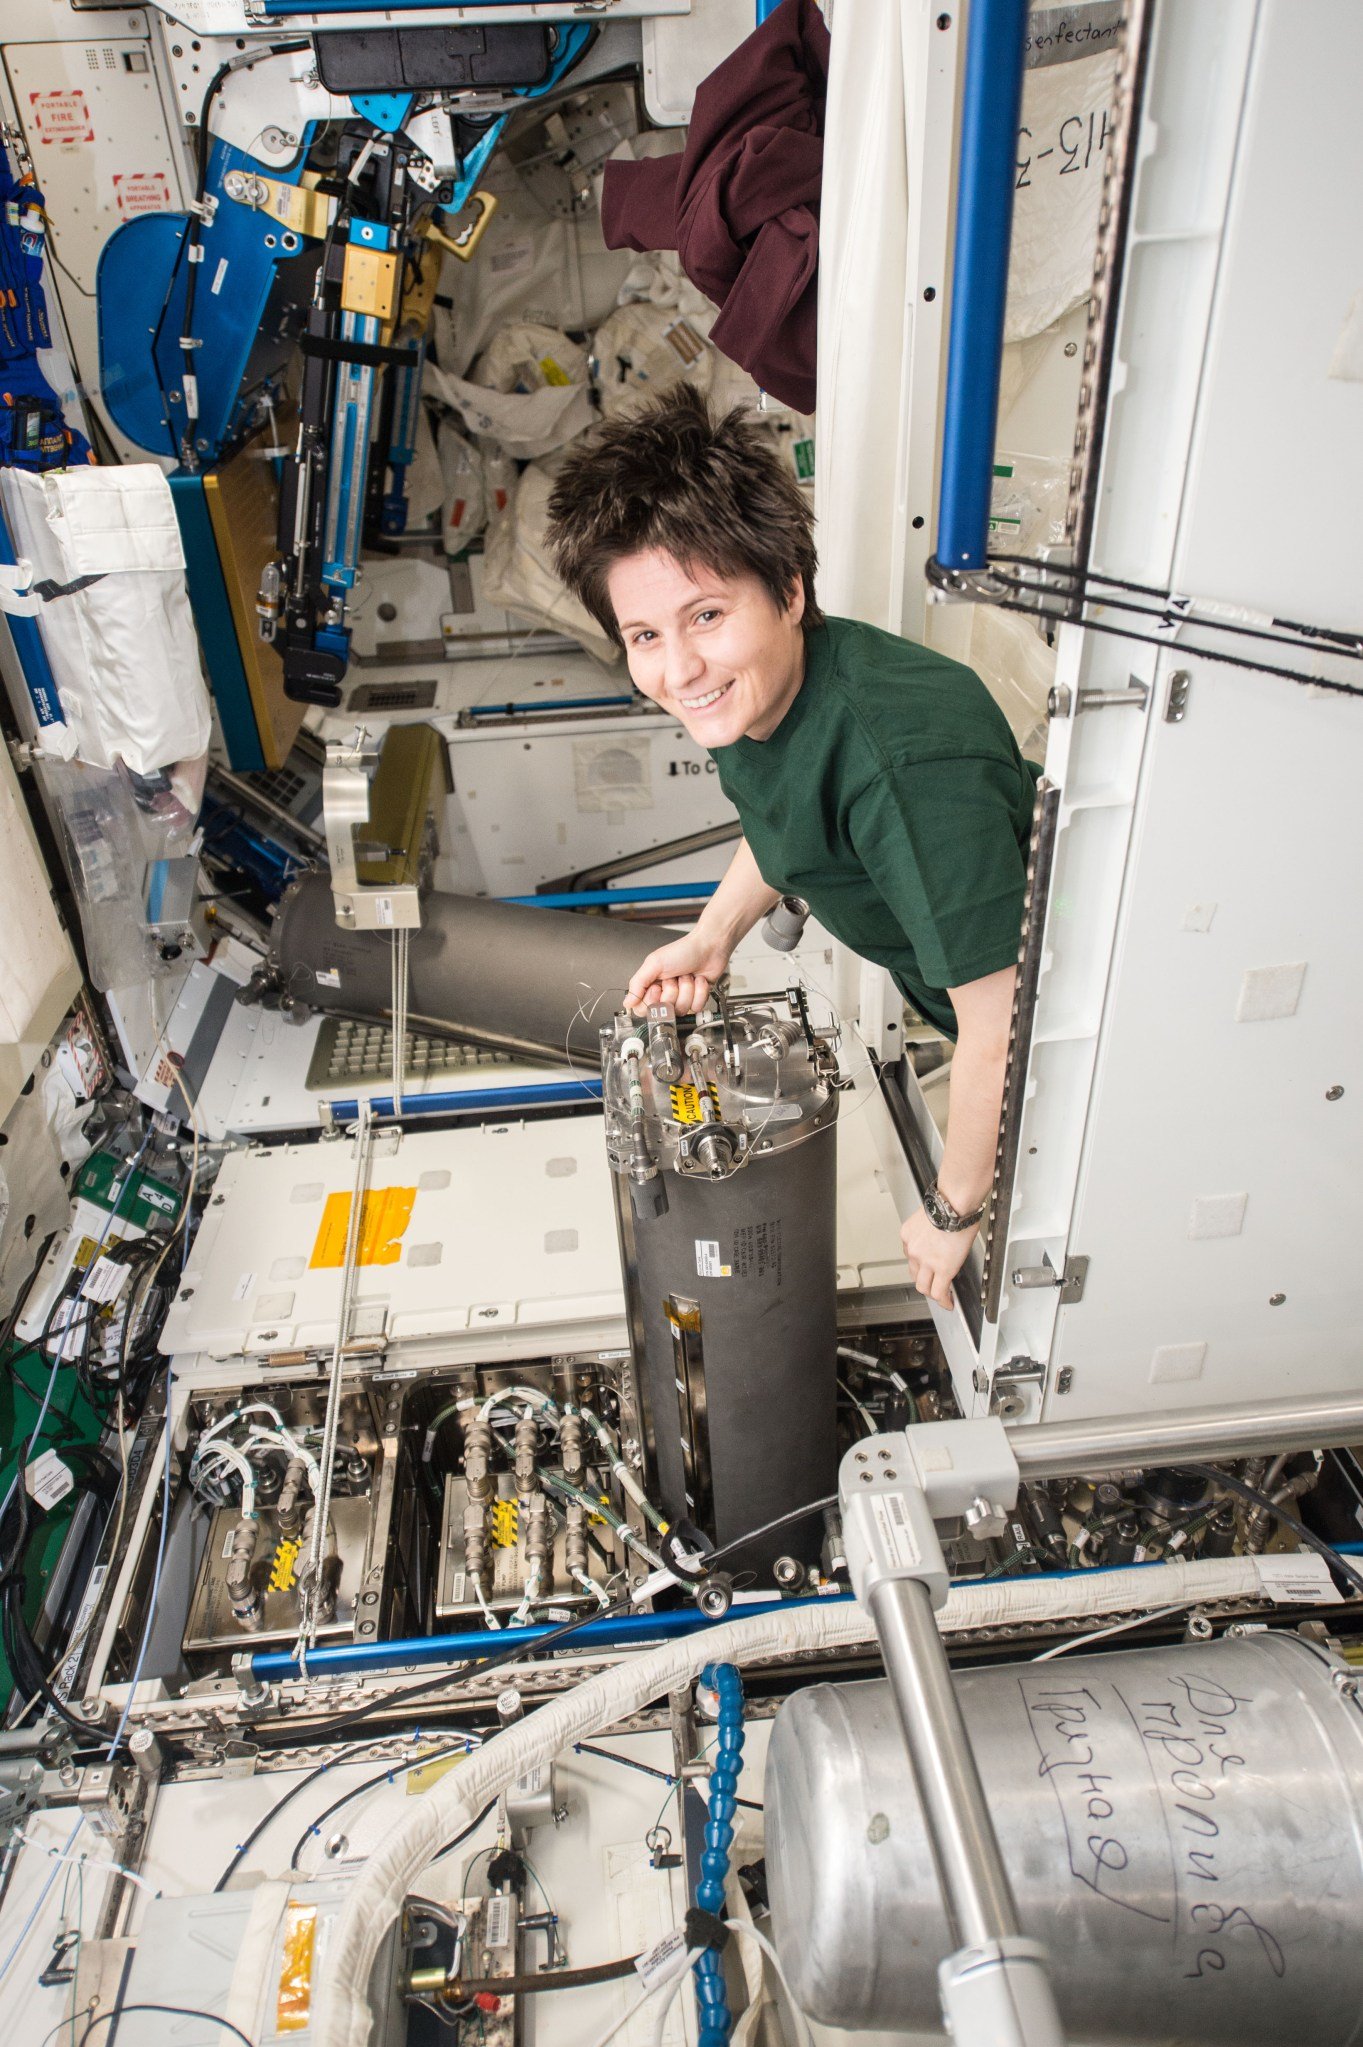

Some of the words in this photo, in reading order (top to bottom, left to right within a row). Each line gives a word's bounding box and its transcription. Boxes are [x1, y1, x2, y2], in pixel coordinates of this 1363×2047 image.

[41, 101, 77, 109] PORTABLE
[51, 113, 74, 121] FIRE
[681, 761, 701, 775] To
[683, 1087, 697, 1119] CAUTION
[1014, 1525, 1024, 1540] RAIL
[60, 1664, 77, 1691] Rack
